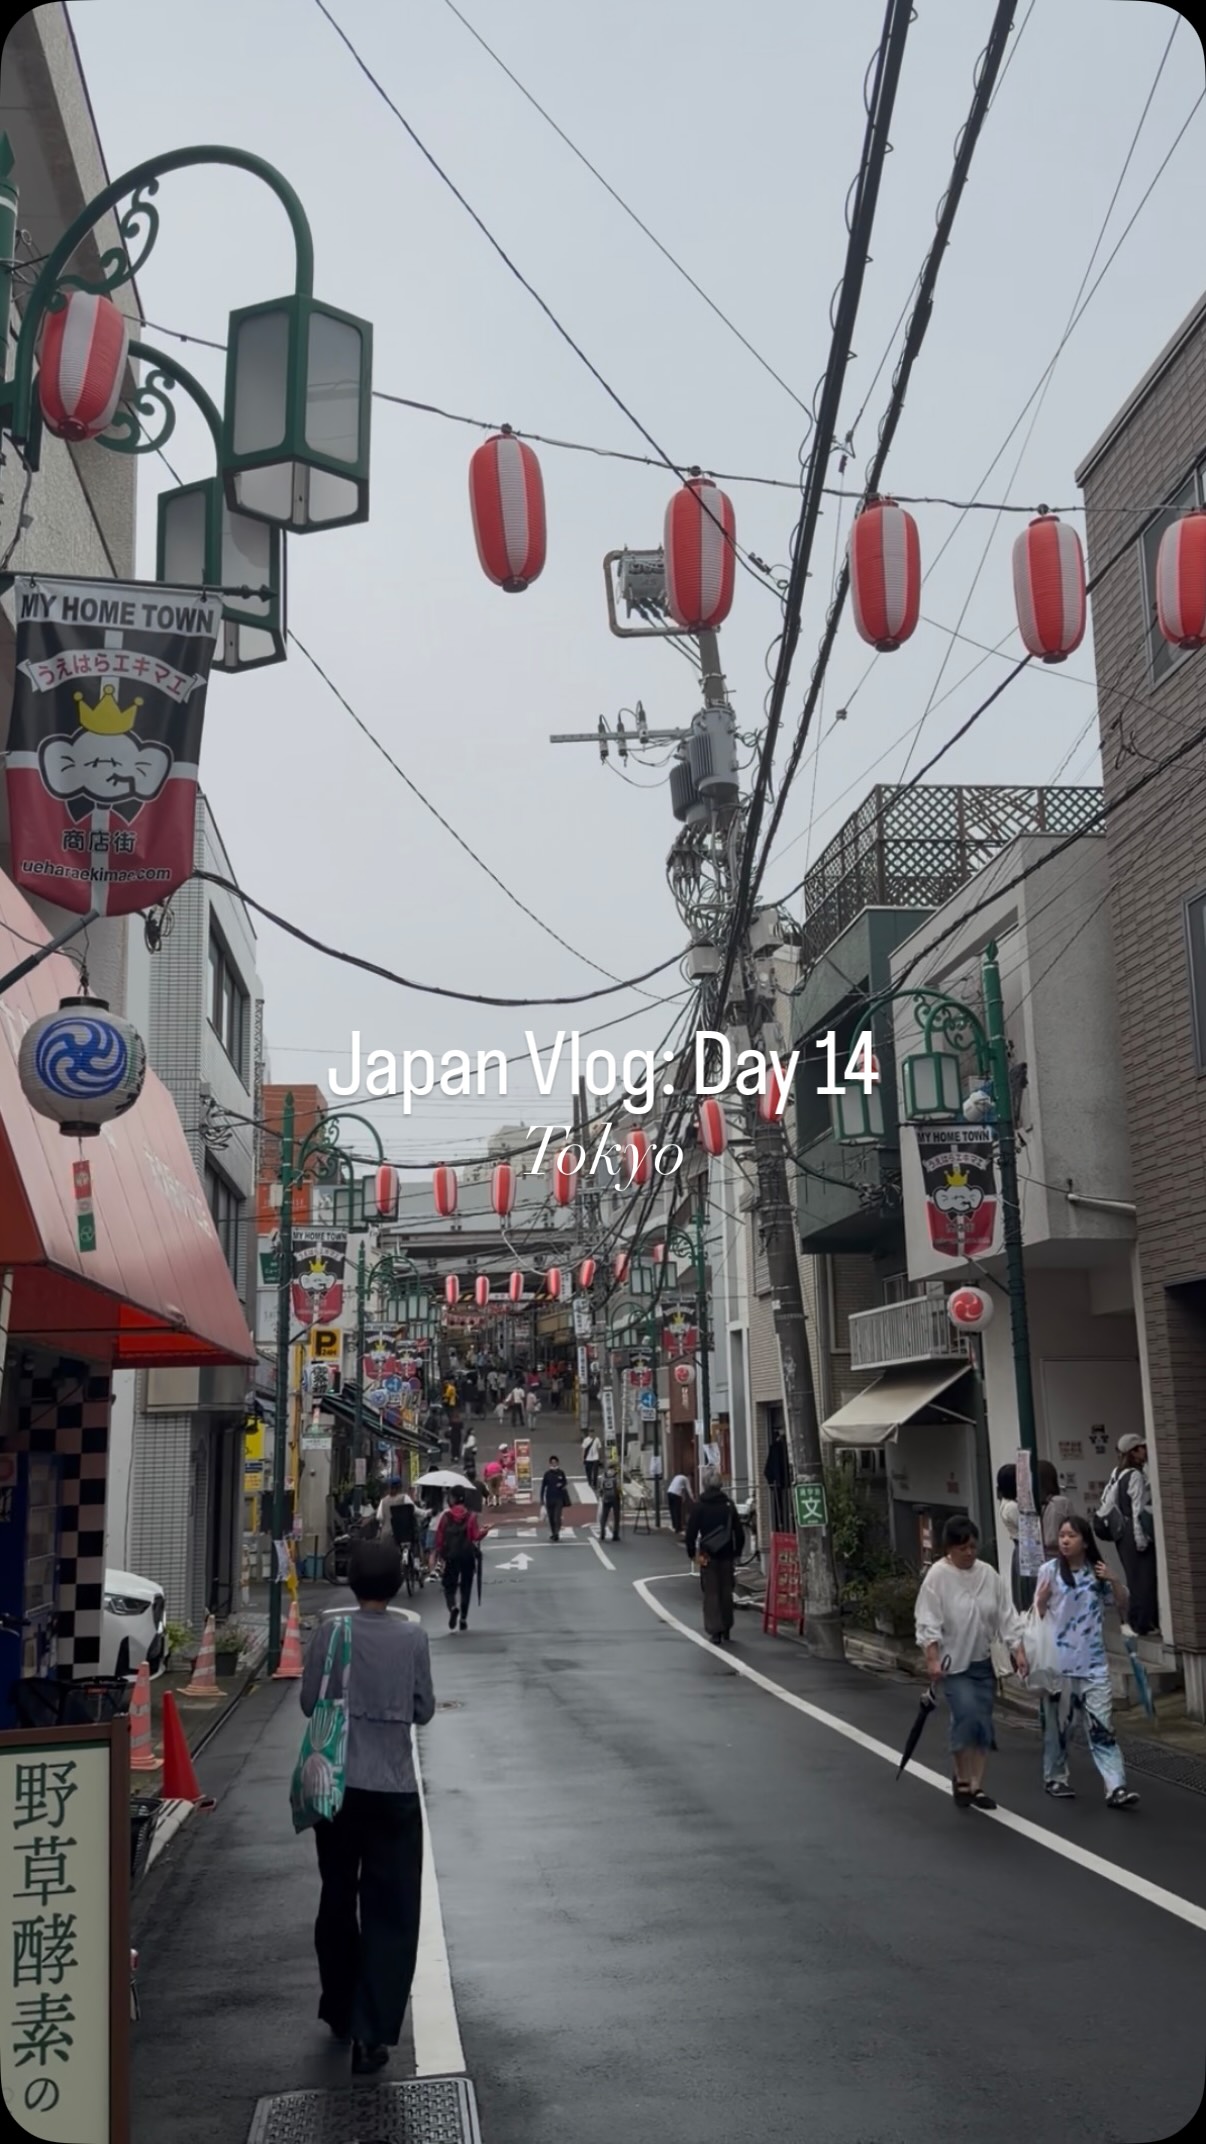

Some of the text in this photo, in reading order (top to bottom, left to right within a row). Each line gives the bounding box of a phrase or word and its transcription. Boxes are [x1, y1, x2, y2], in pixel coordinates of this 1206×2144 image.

[21, 593, 214, 634] MY HOME TOWN
[38, 653, 187, 696] うえはらエキマエ
[63, 830, 135, 853] 商店街
[22, 860, 171, 881] ueharaekimae.com
[917, 1130, 990, 1143] MY HOME TOWN
[293, 1231, 347, 1240] MY HOME TOWN
[315, 1331, 337, 1356] P
[801, 1496, 823, 1519] 文
[11, 1759, 79, 2113] 野草酵素の
